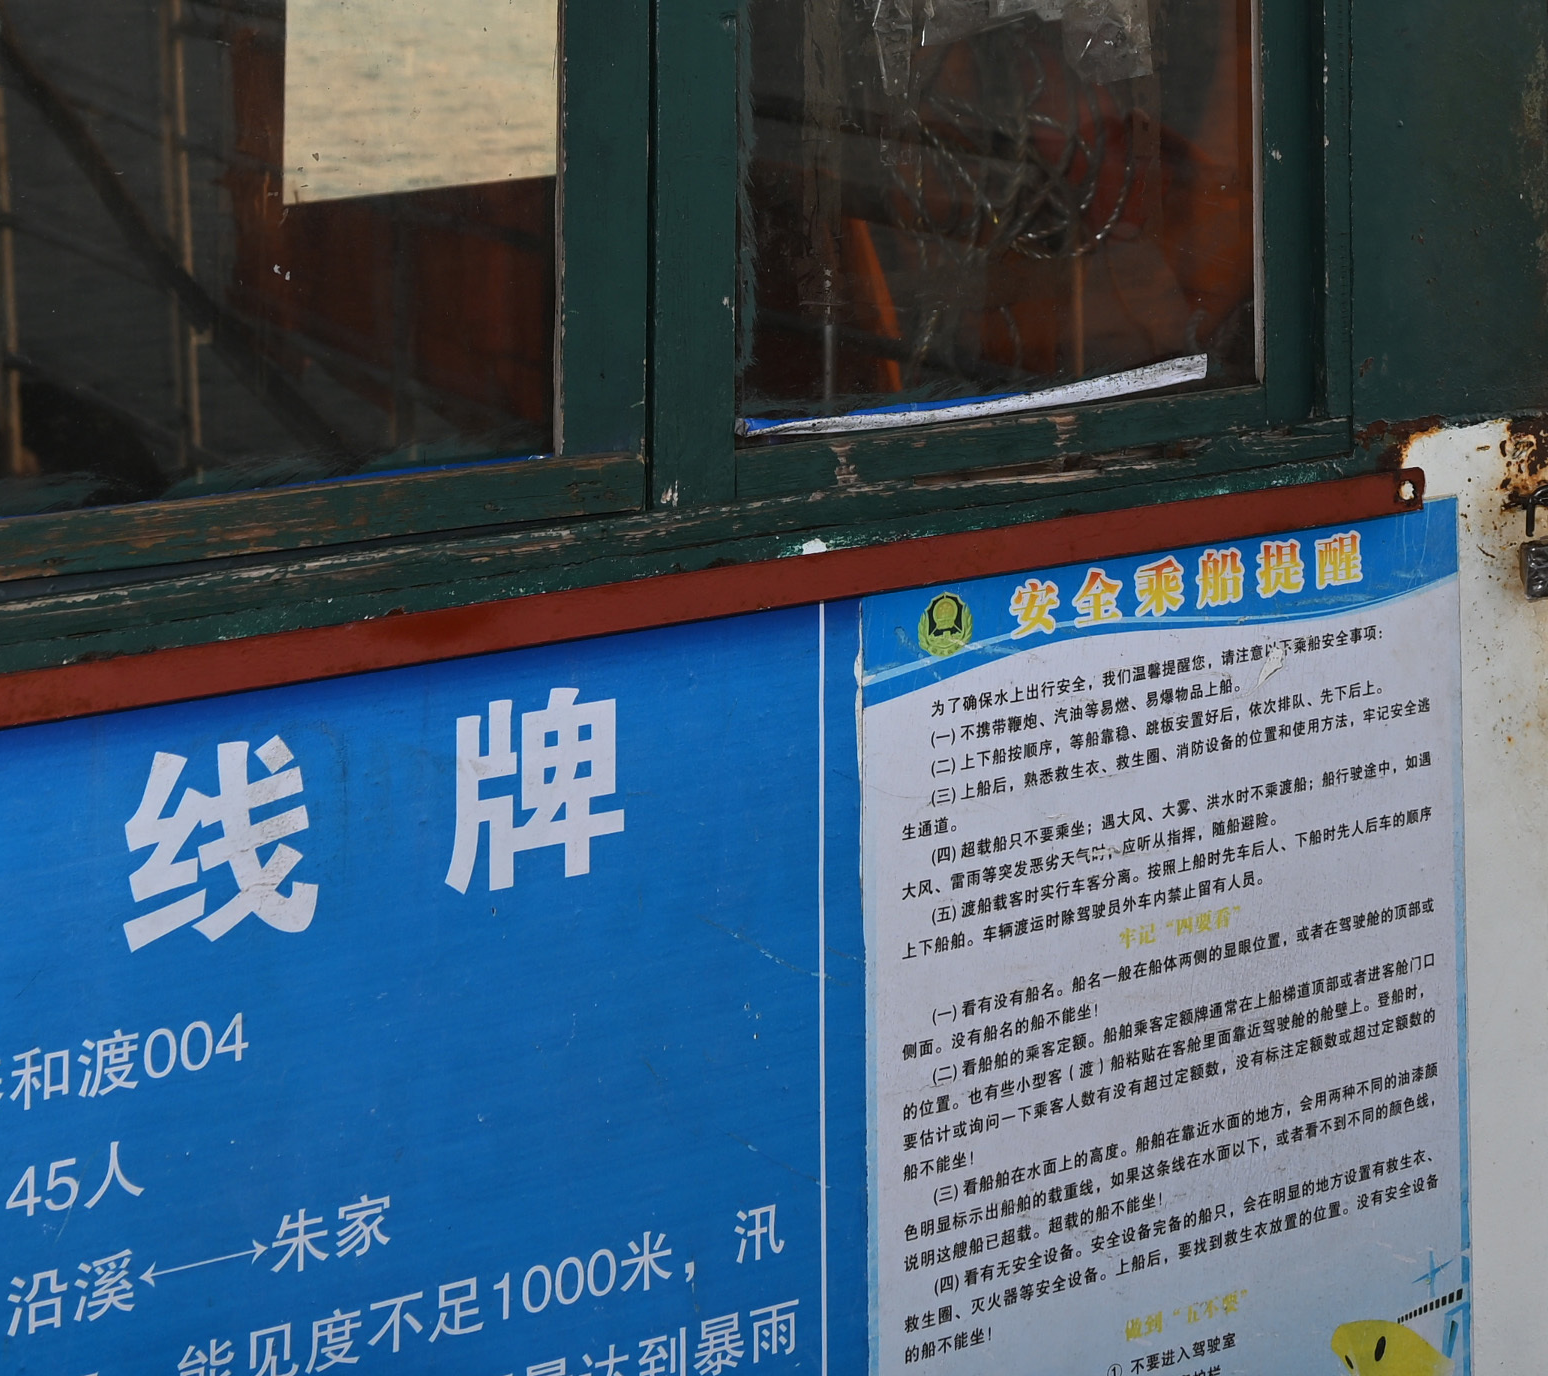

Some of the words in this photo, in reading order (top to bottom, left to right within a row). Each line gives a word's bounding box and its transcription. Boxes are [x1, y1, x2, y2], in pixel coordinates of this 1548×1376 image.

[1010, 531, 1362, 638] 安全乘船提醒
[902, 817, 956, 840] 生通道。
[903, 1151, 973, 1182] 船不能坐！
[905, 1328, 991, 1364] 的船不能坐！
